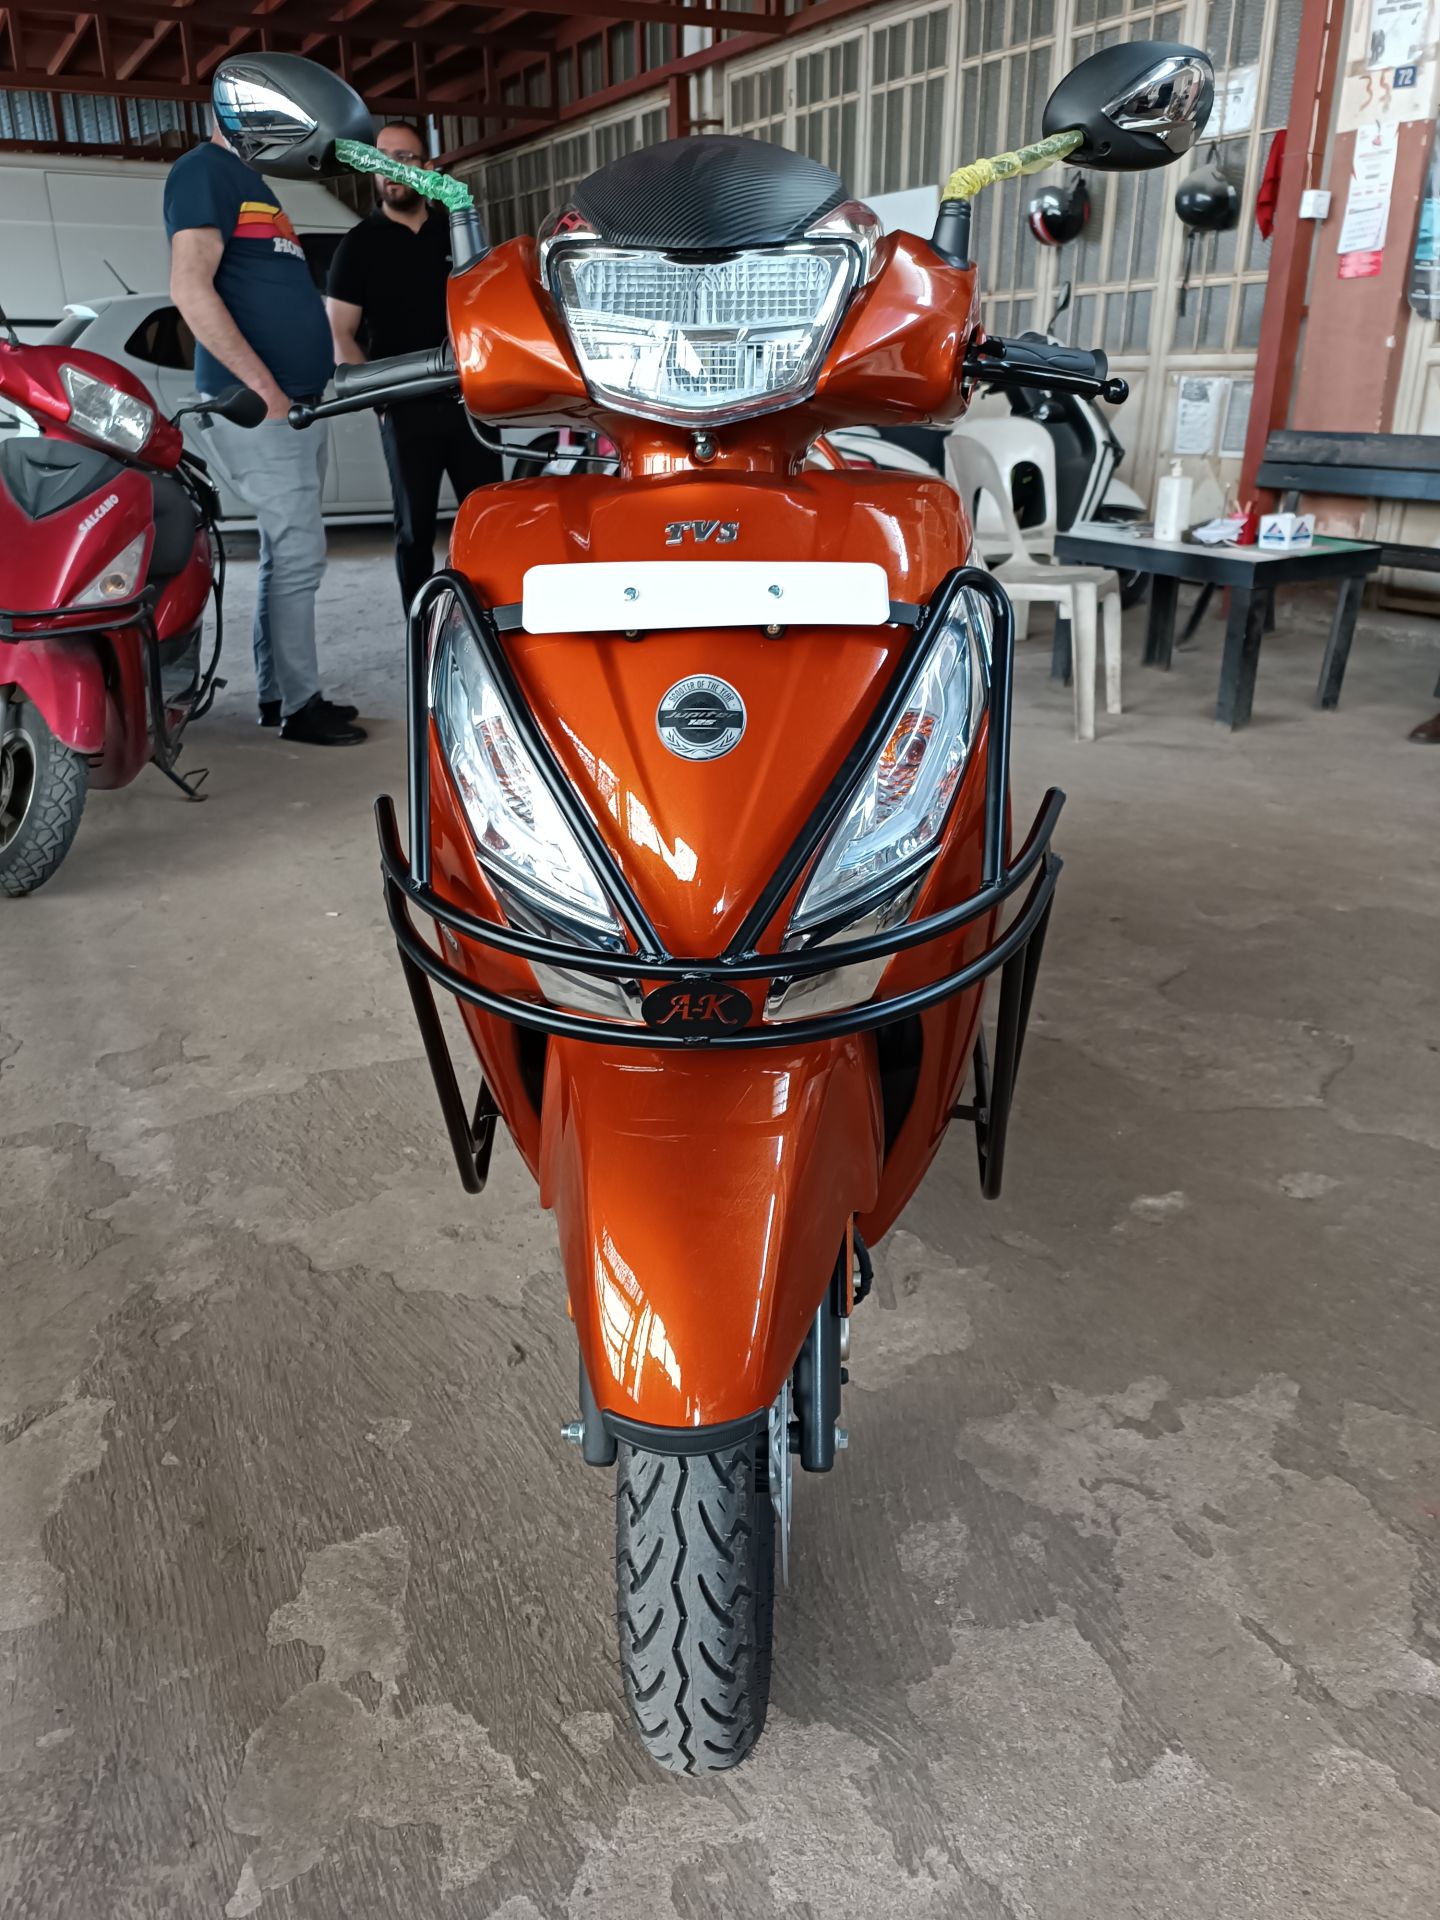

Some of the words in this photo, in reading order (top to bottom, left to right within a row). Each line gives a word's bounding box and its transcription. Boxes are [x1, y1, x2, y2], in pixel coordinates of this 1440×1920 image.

[1398, 68, 1414, 86] 72
[78, 494, 119, 532] SALCANO
[664, 520, 740, 546] TVS
[668, 681, 695, 702] SCOOTER
[697, 681, 705, 689] OF
[707, 681, 719, 691] THE
[720, 687, 735, 702] YEAR
[656, 993, 738, 1025] A-K
